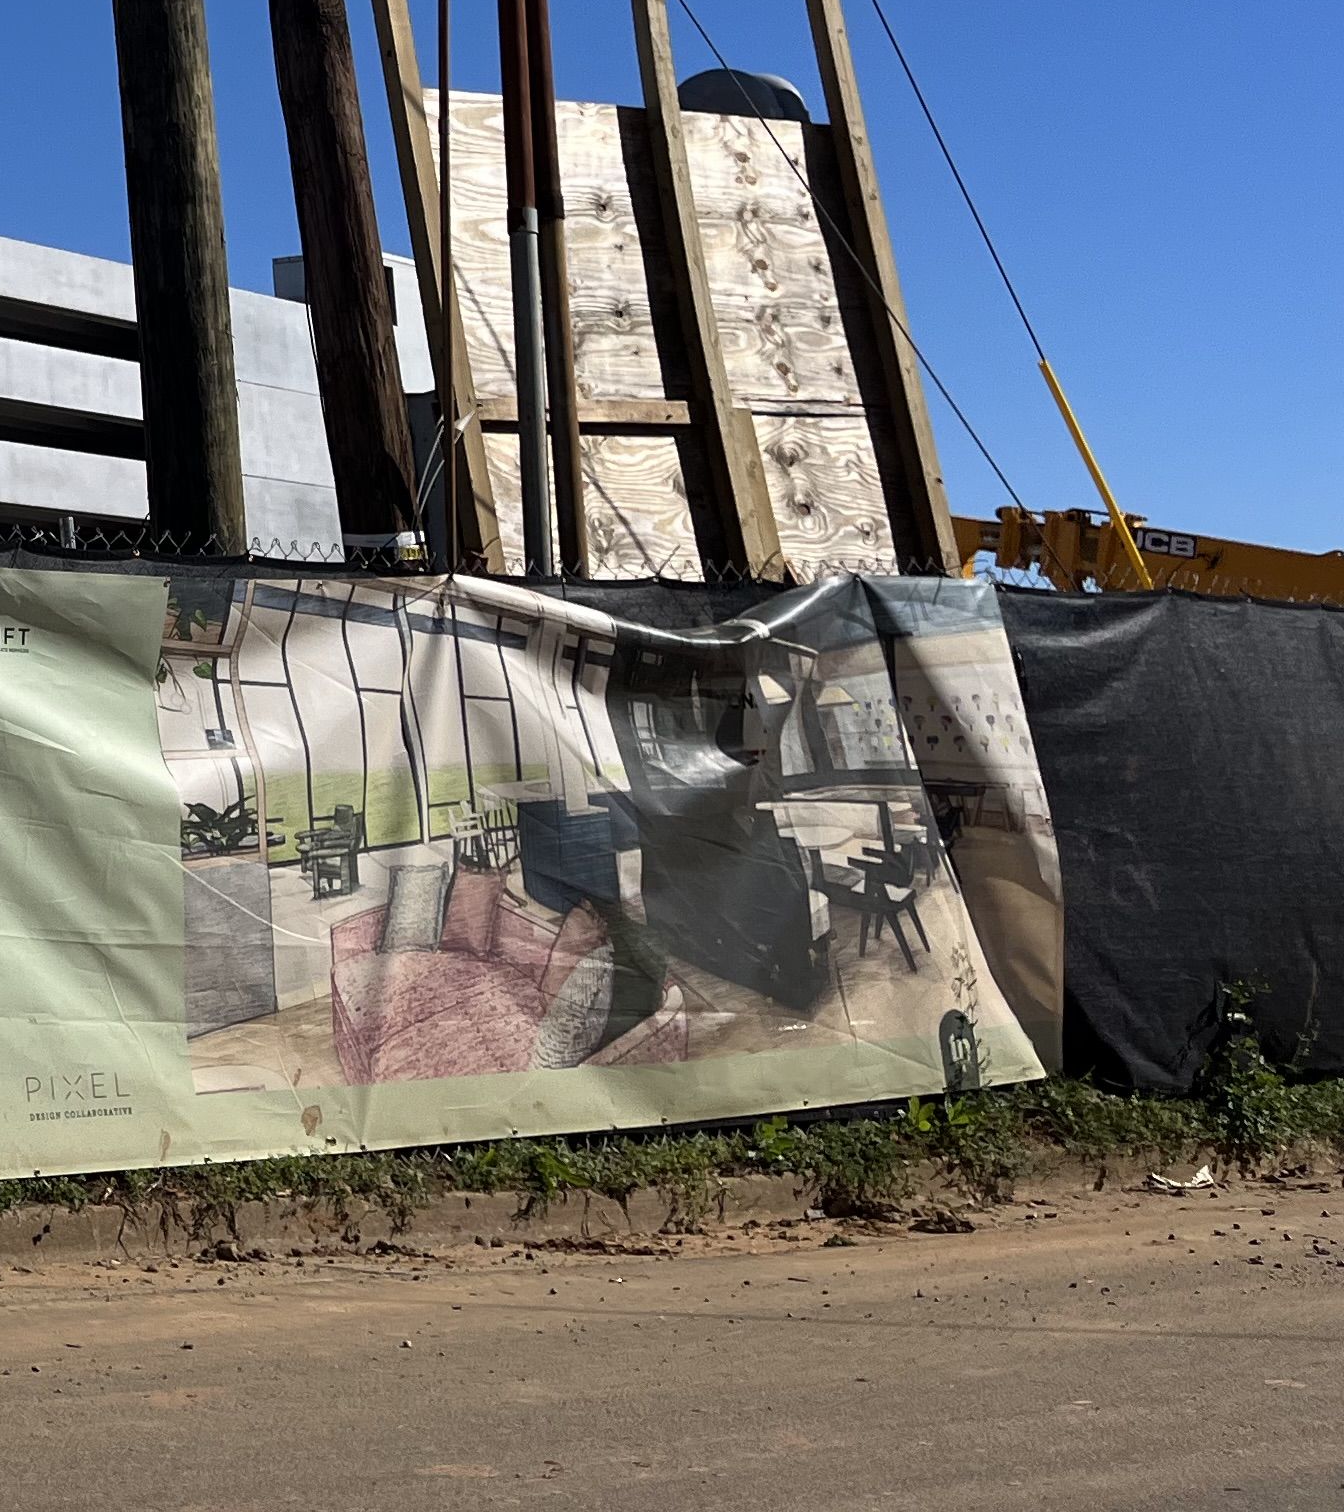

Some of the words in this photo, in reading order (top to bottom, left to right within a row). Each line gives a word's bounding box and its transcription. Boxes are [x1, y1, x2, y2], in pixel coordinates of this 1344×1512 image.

[25, 1072, 131, 1102] PIXEL
[29, 1112, 61, 1122] DESIGN
[64, 1107, 133, 1119] COLLABORATIVE
